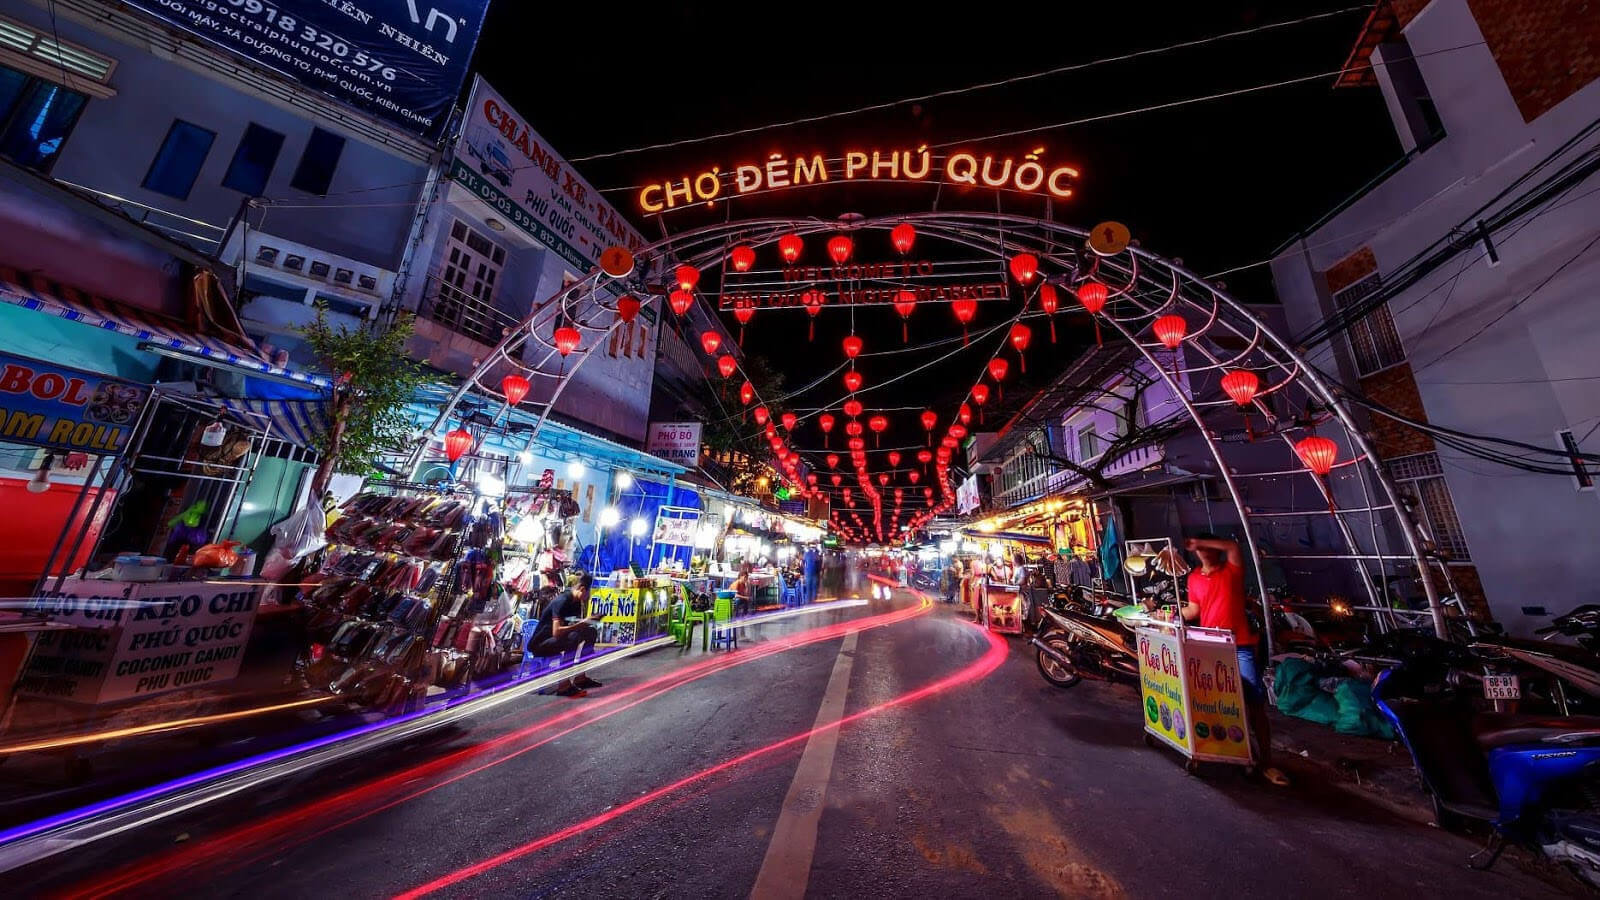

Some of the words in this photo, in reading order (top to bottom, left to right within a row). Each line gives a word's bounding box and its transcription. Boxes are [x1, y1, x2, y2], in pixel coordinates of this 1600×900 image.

[300, 26, 349, 58] 320
[352, 50, 397, 80] 576
[379, 22, 449, 66] NHIÊN
[401, 108, 432, 126] GIANG
[484, 99, 560, 181] CHÀNH
[640, 167, 718, 211] CHỢ
[735, 154, 827, 193] ĐÊM
[847, 144, 929, 179] PHÚ
[947, 147, 1078, 197] QUỐC
[481, 184, 513, 213] 0903
[514, 209, 537, 233] 999
[539, 230, 556, 247] 812
[525, 189, 549, 218] PHÚ
[549, 208, 576, 239] QUỐC
[782, 263, 894, 282] WELCOME
[917, 282, 1008, 301] MARKET
[48, 419, 120, 451] ROLL
[672, 449, 696, 458] RANG
[131, 595, 201, 625] KẸO
[590, 592, 614, 617] Thốt
[617, 592, 635, 617] Nốt
[128, 623, 180, 651] PHÚ
[184, 617, 243, 646] QUỐC
[115, 653, 194, 677] COCONUT
[196, 646, 241, 665] CANDY
[135, 676, 171, 693] PHU
